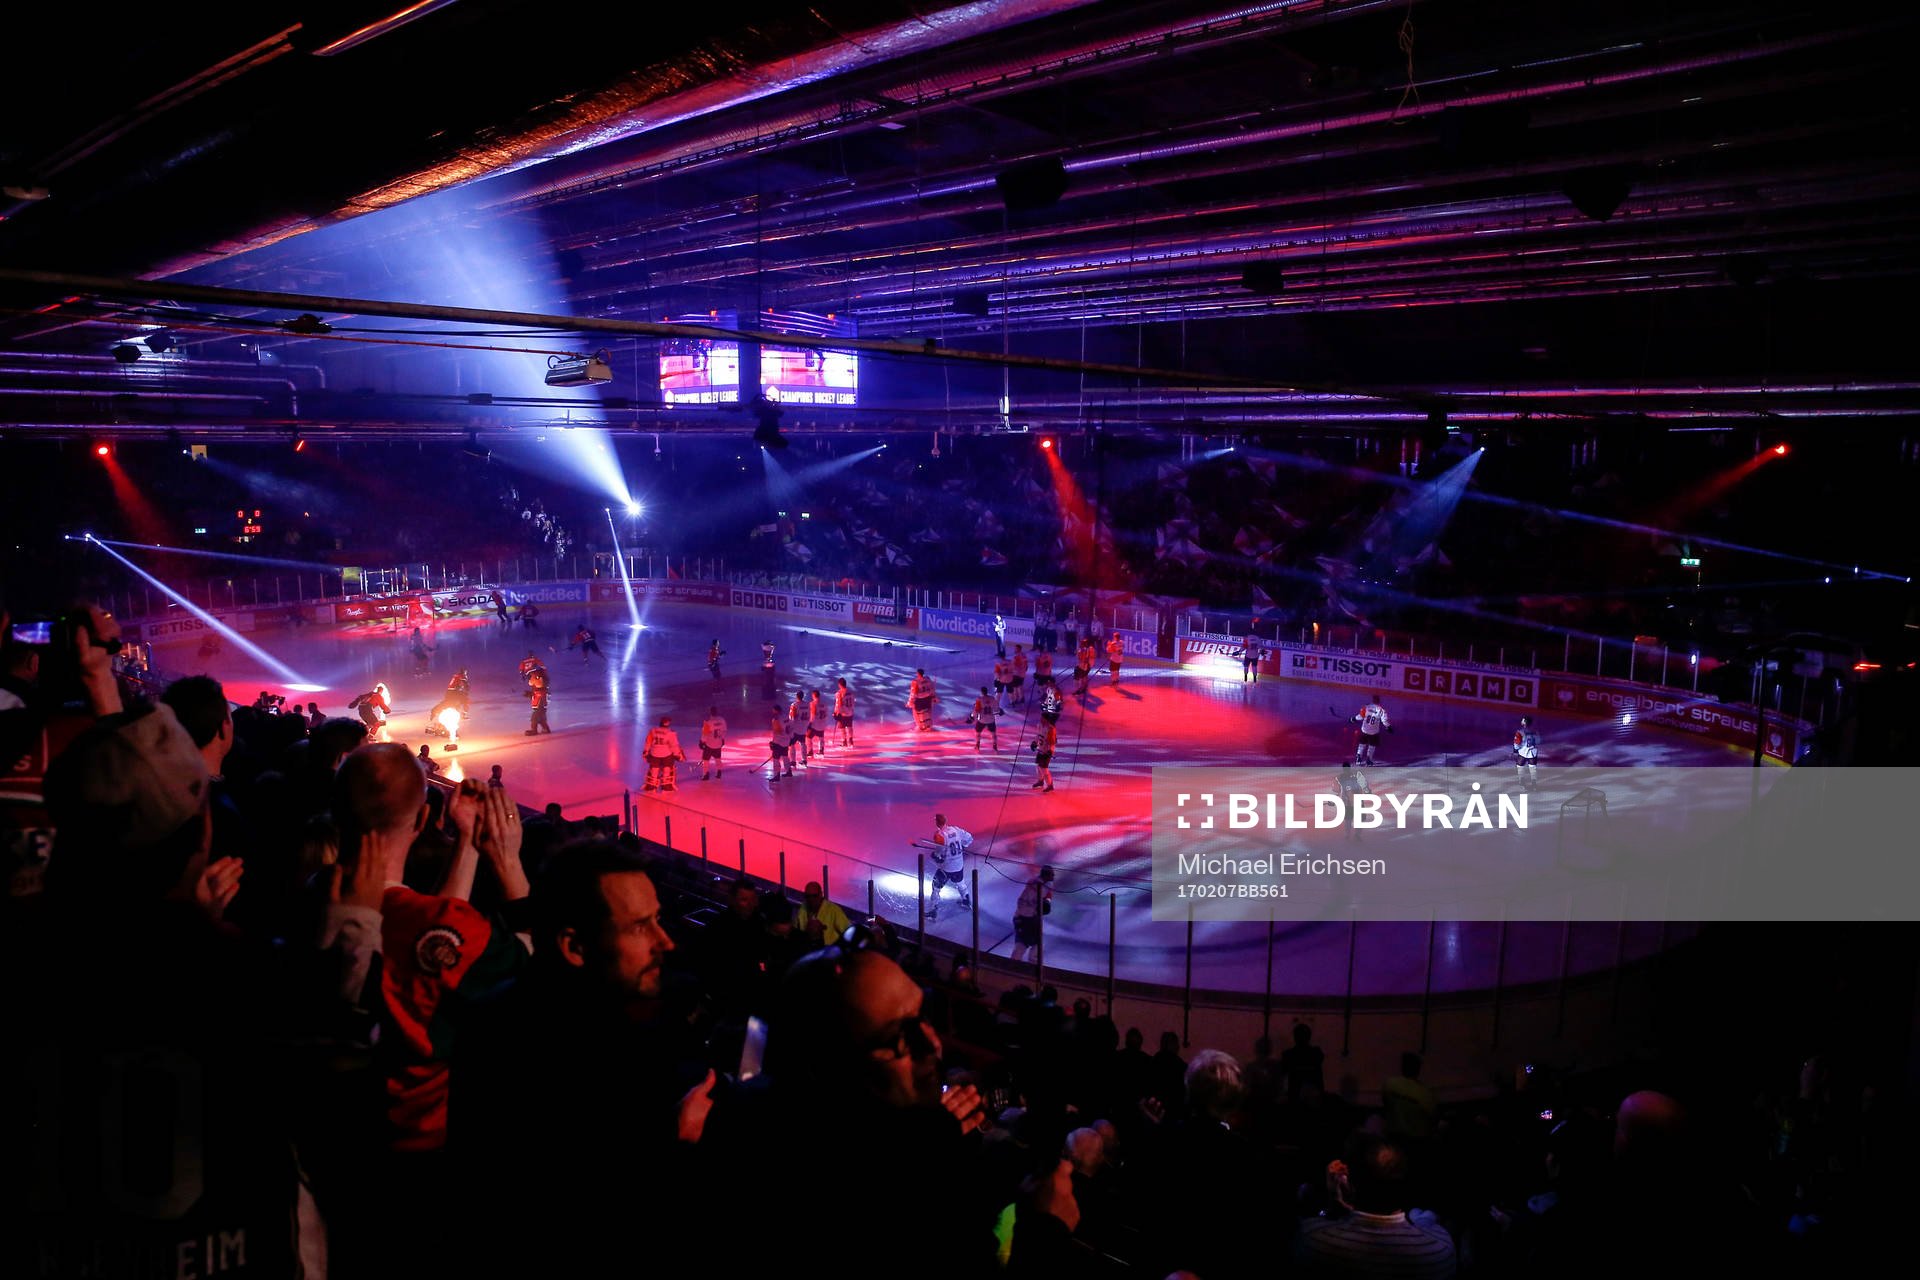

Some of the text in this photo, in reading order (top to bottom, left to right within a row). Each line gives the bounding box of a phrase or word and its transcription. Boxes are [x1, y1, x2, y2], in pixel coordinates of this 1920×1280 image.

[808, 599, 846, 613] TISSOT
[926, 614, 990, 636] NordicBet
[1320, 656, 1392, 678] TISSOT
[1409, 672, 1527, 698] CRAMO
[1586, 690, 1685, 717] engelbert
